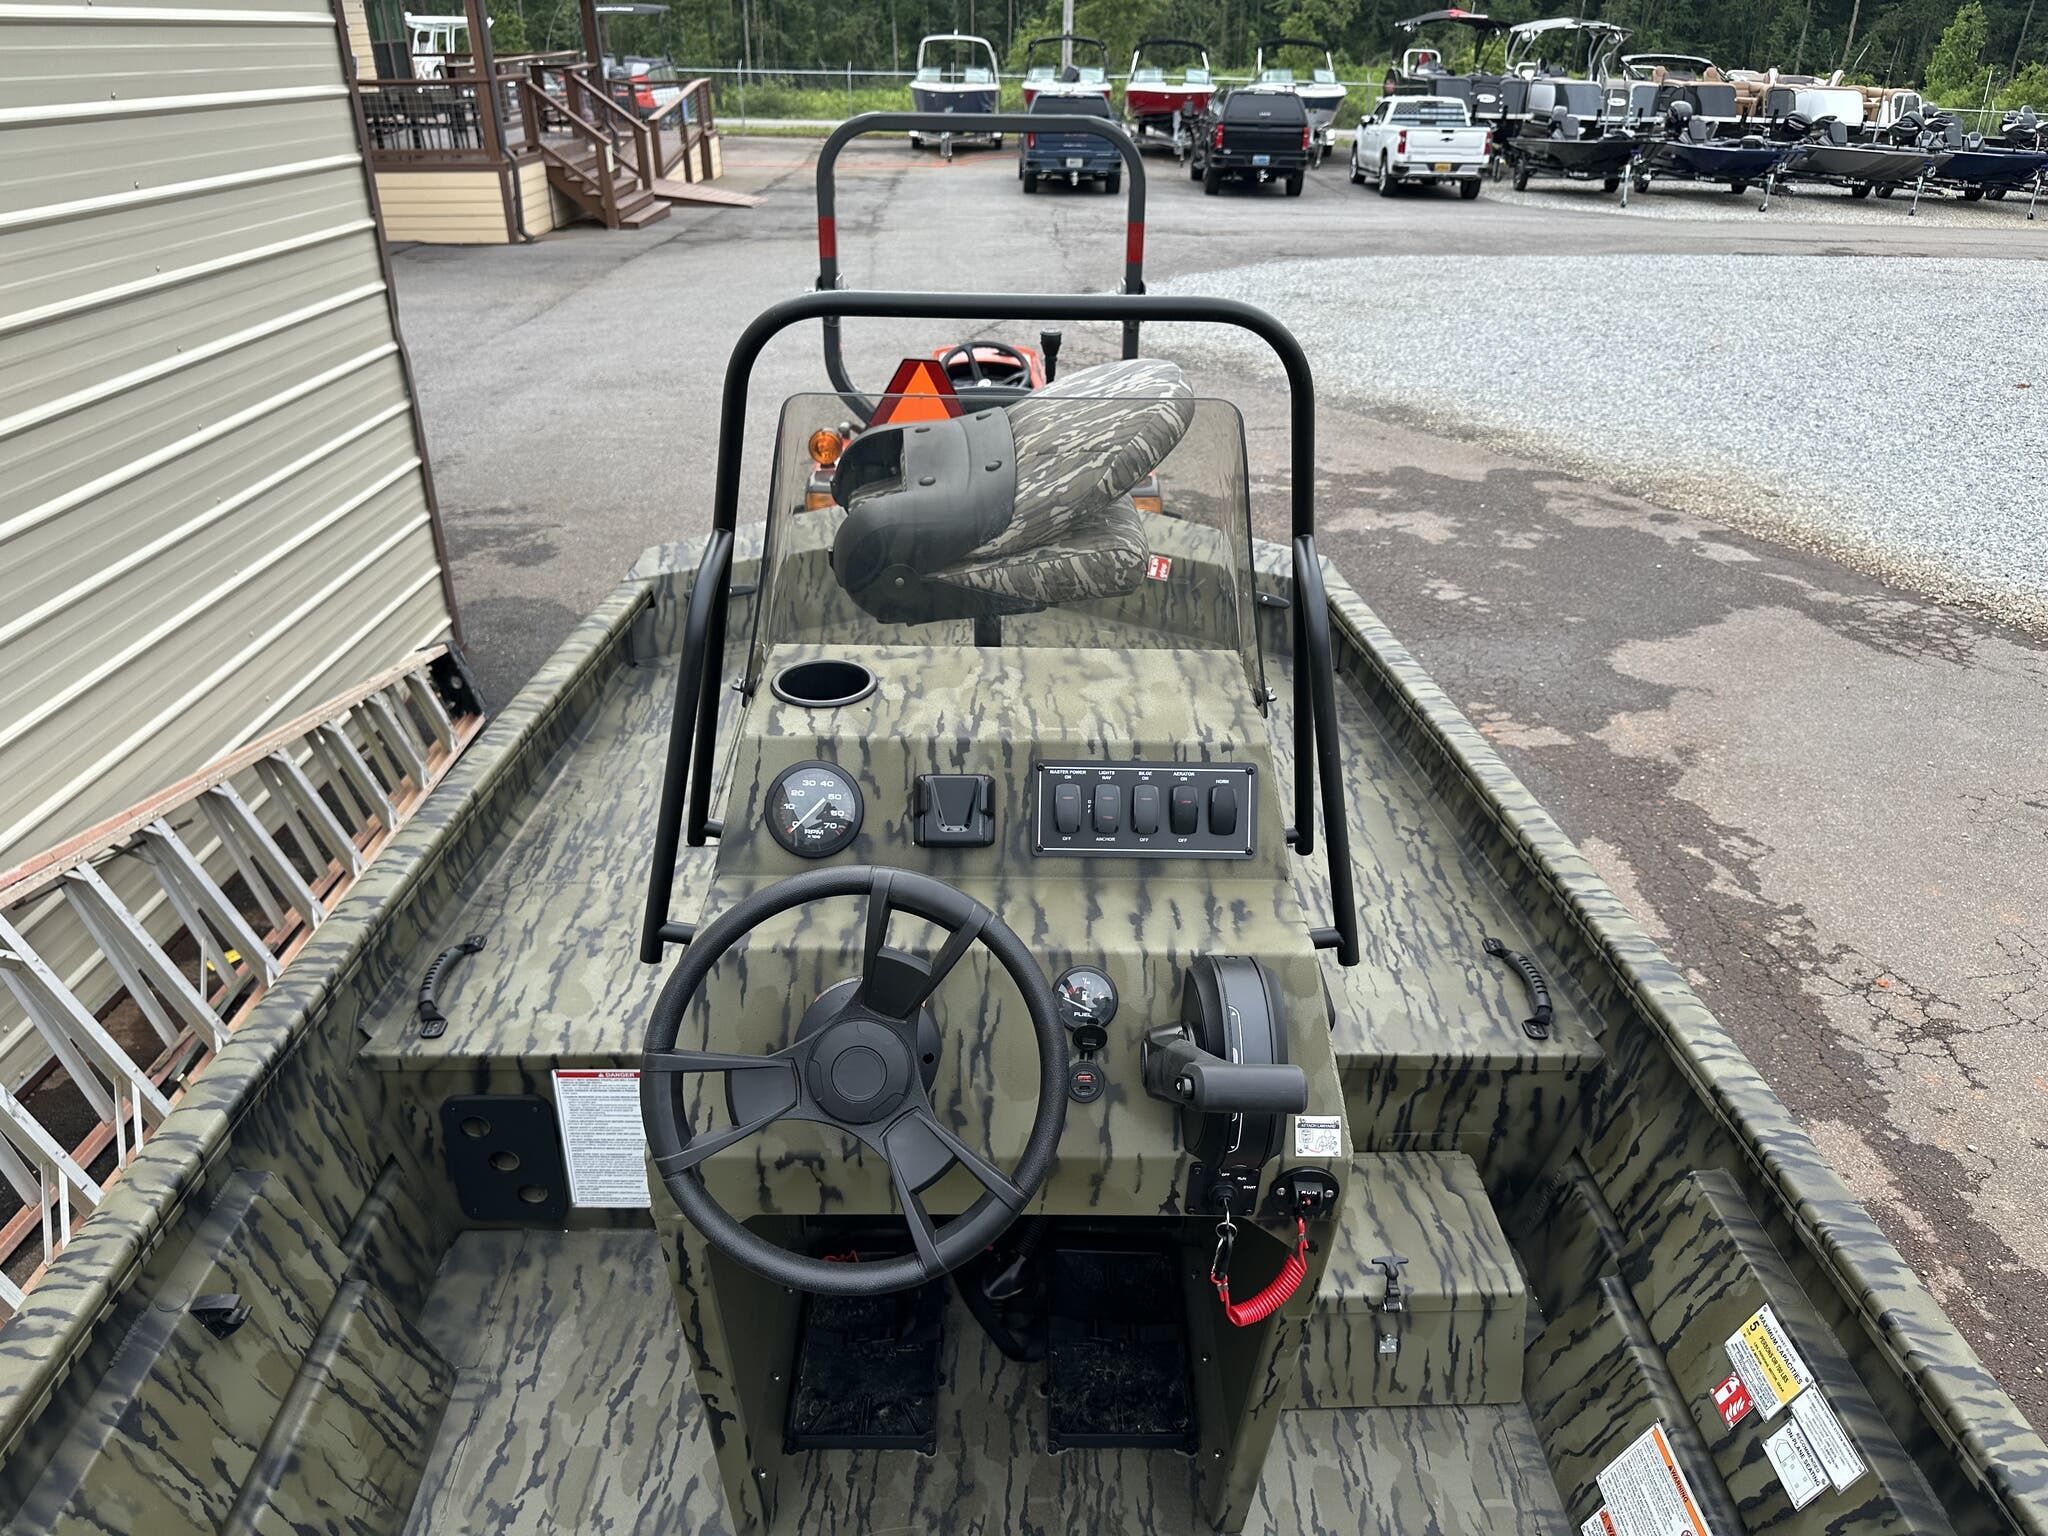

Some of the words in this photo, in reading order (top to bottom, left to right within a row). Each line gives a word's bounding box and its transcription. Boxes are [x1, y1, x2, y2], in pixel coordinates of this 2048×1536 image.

[1750, 1320, 1760, 1331] 5
[1759, 1336, 1773, 1358] PERSONS
[1770, 1356, 1778, 1366] OR
[1780, 1373, 1789, 1383] LBS
[1760, 1314, 1778, 1345] MAXIMUM
[1777, 1345, 1802, 1385] CAPACITIES
[1795, 1432, 1820, 1473] RECOMMENDED
[1671, 1469, 1689, 1503] WARNING
[1804, 1459, 1820, 1487] SEATING
